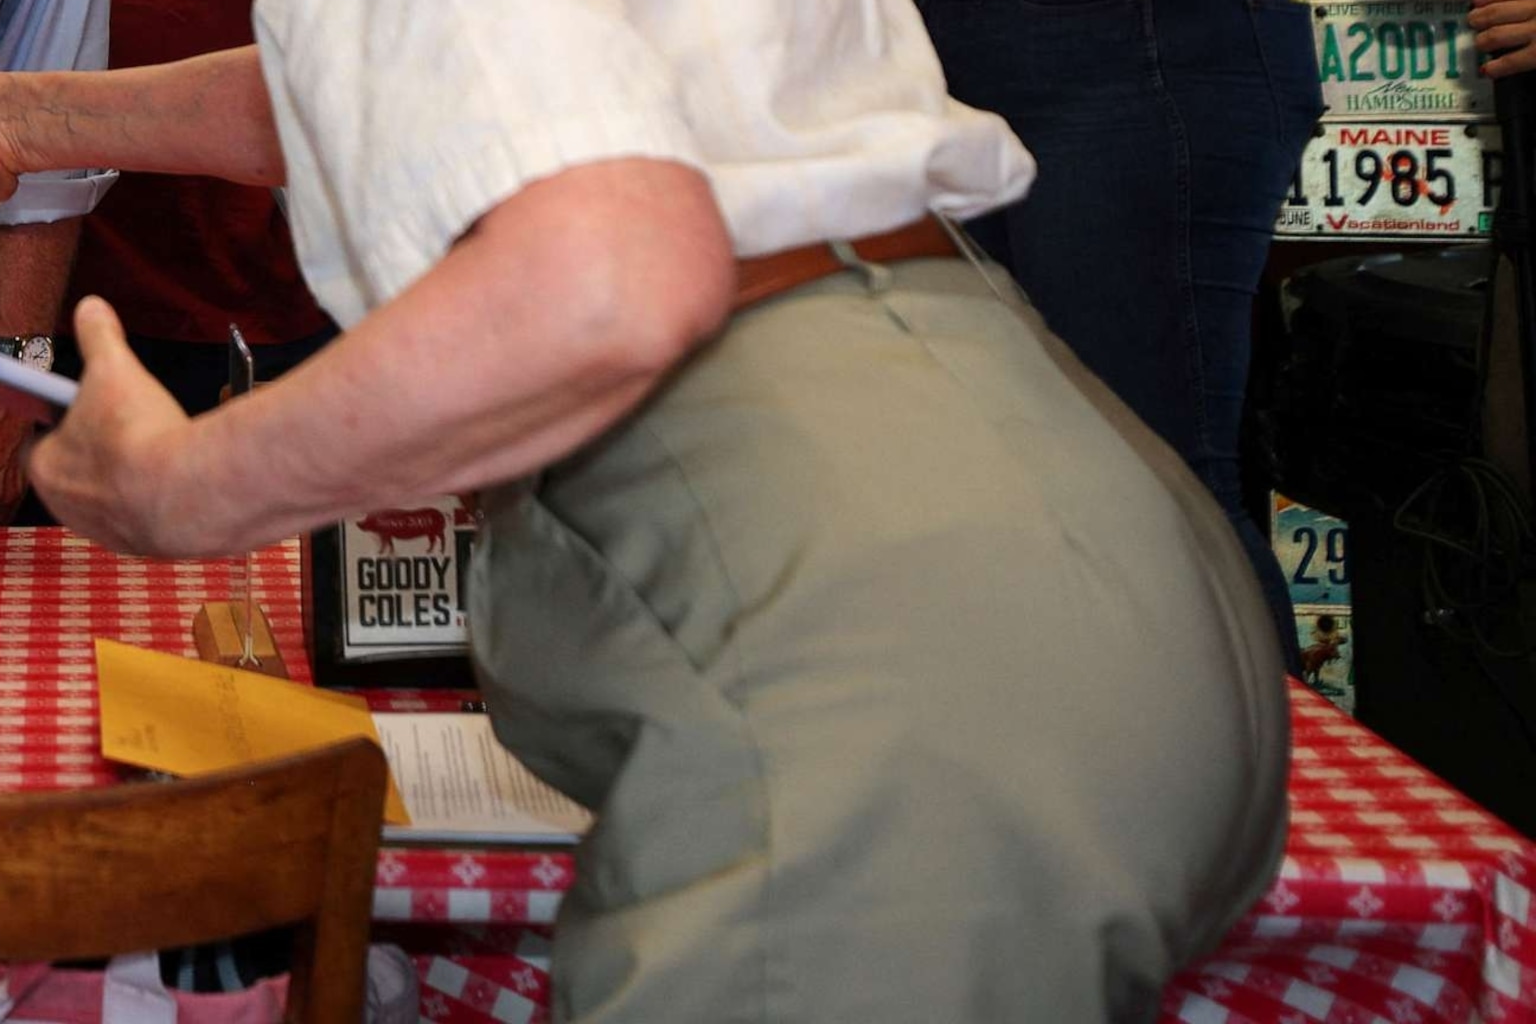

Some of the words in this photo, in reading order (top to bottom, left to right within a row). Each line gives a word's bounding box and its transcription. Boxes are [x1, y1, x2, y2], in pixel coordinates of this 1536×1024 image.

[1328, 5, 1358, 16] LIVE
[1368, 4, 1402, 16] FREE
[1414, 3, 1433, 15] OR
[1346, 93, 1460, 111] HAMPSHIRE
[1340, 128, 1450, 146] MAINE
[1280, 211, 1311, 225] JUNE
[1327, 214, 1460, 232] Vacationland
[357, 557, 451, 591] GOODY
[358, 593, 451, 627] COLES
